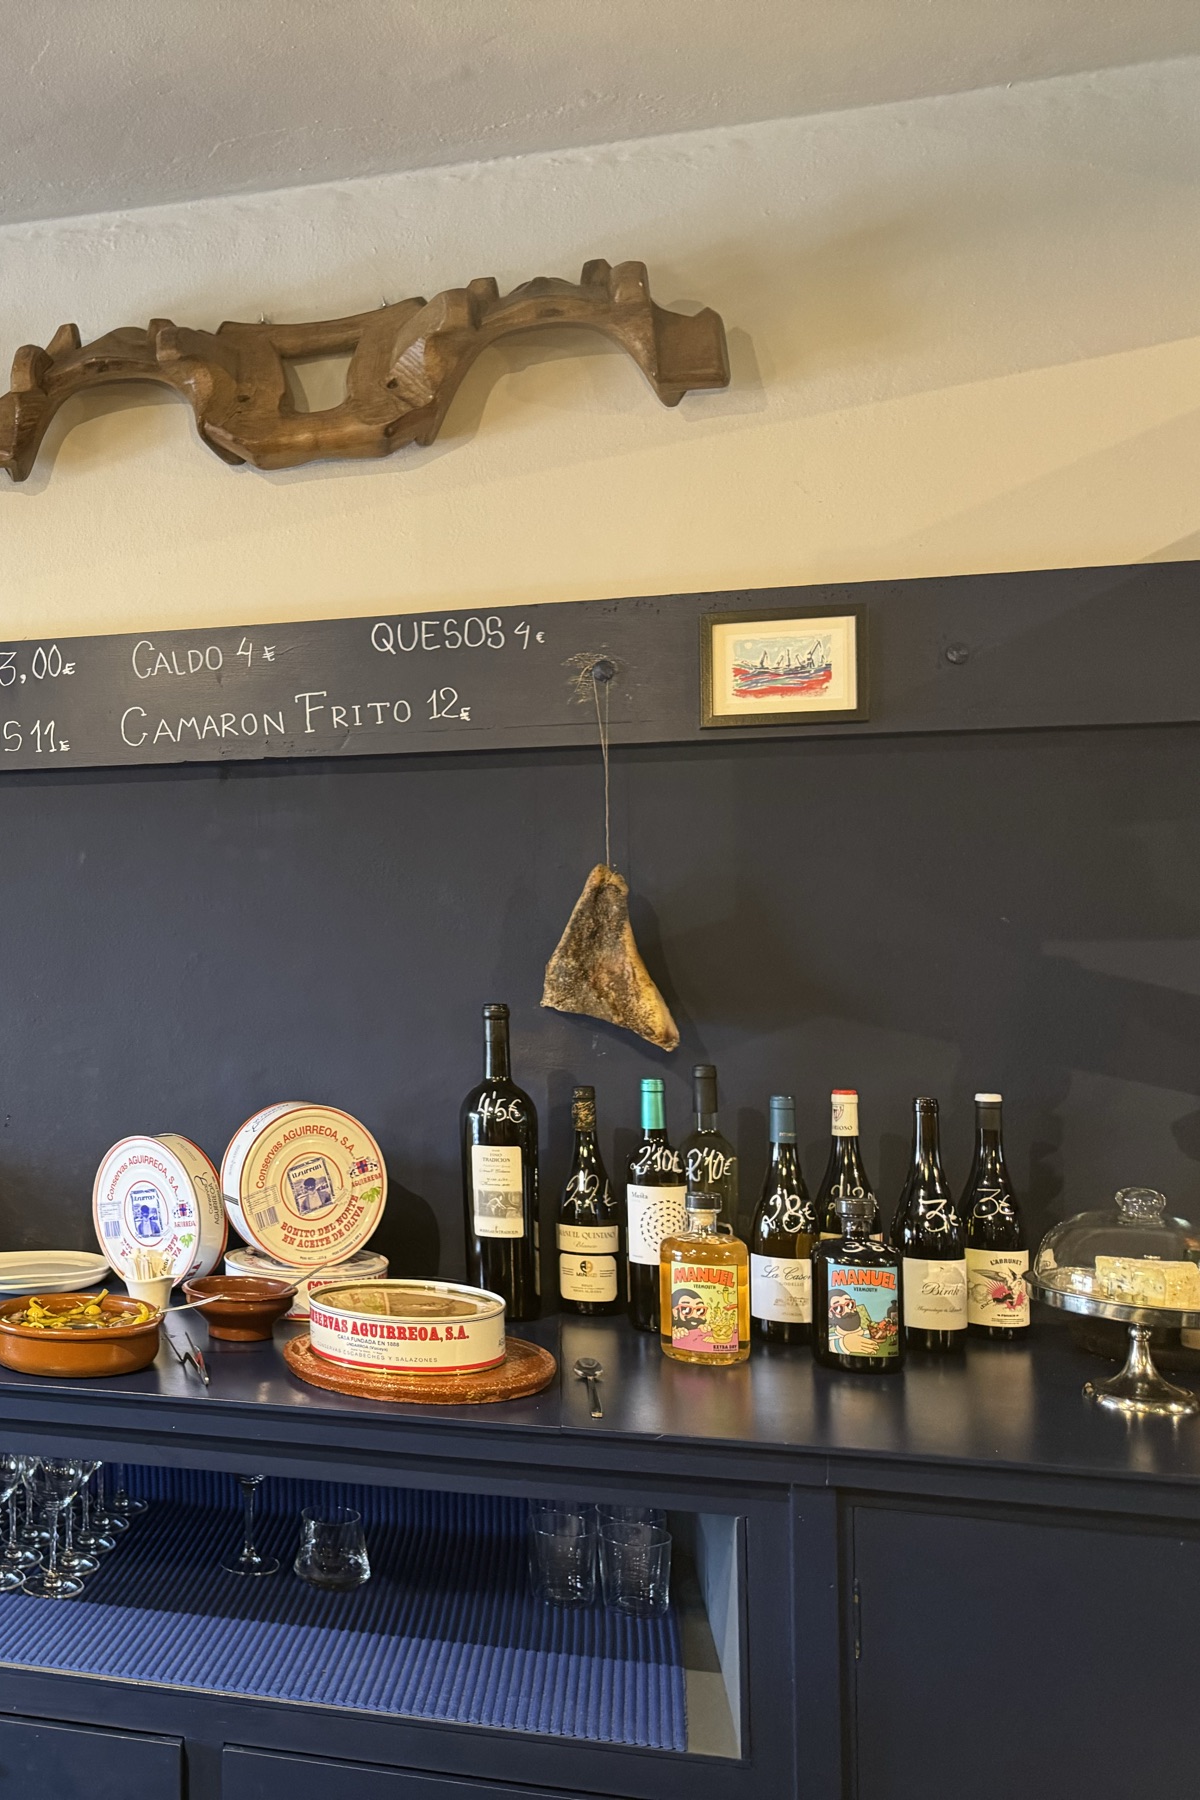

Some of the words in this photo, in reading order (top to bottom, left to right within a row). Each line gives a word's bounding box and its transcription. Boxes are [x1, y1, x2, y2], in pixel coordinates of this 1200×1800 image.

[371, 616, 505, 654] QUESOS
[132, 640, 223, 679] CALDO
[121, 706, 285, 747] CAMARON
[294, 690, 412, 733] FRITO
[107, 1163, 128, 1201] Conservas
[256, 1141, 283, 1189] Conservas
[281, 1221, 316, 1238] BONITO
[317, 1223, 336, 1236] DEL
[336, 1195, 359, 1226] NORTE
[282, 1234, 296, 1245] EN
[297, 1235, 331, 1248] ACEITE
[331, 1230, 345, 1242] DE
[344, 1206, 364, 1231] OLIVA
[673, 1266, 736, 1288] MANUEL
[831, 1268, 897, 1291] MANUEL
[445, 1325, 470, 1340] S.A.
